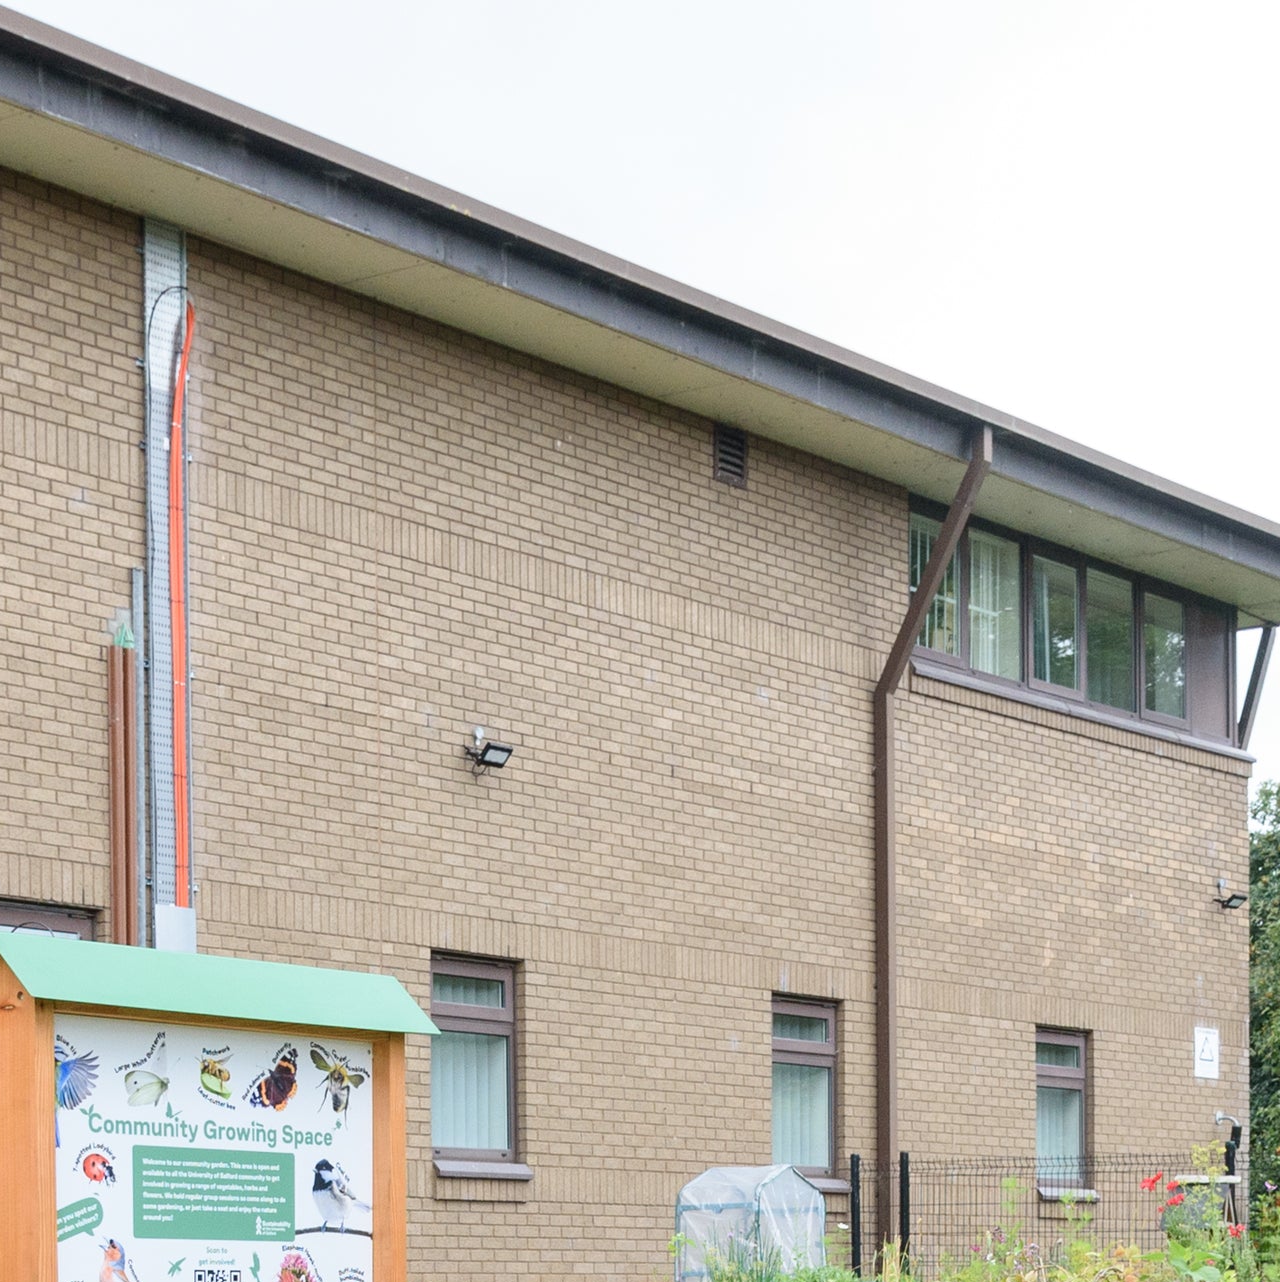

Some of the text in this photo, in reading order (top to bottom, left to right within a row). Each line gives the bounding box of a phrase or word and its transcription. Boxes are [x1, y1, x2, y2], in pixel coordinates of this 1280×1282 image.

[113, 1063, 131, 1074] Large
[146, 1031, 166, 1059] Butterfly
[89, 1112, 333, 1149] Community Growing Space
